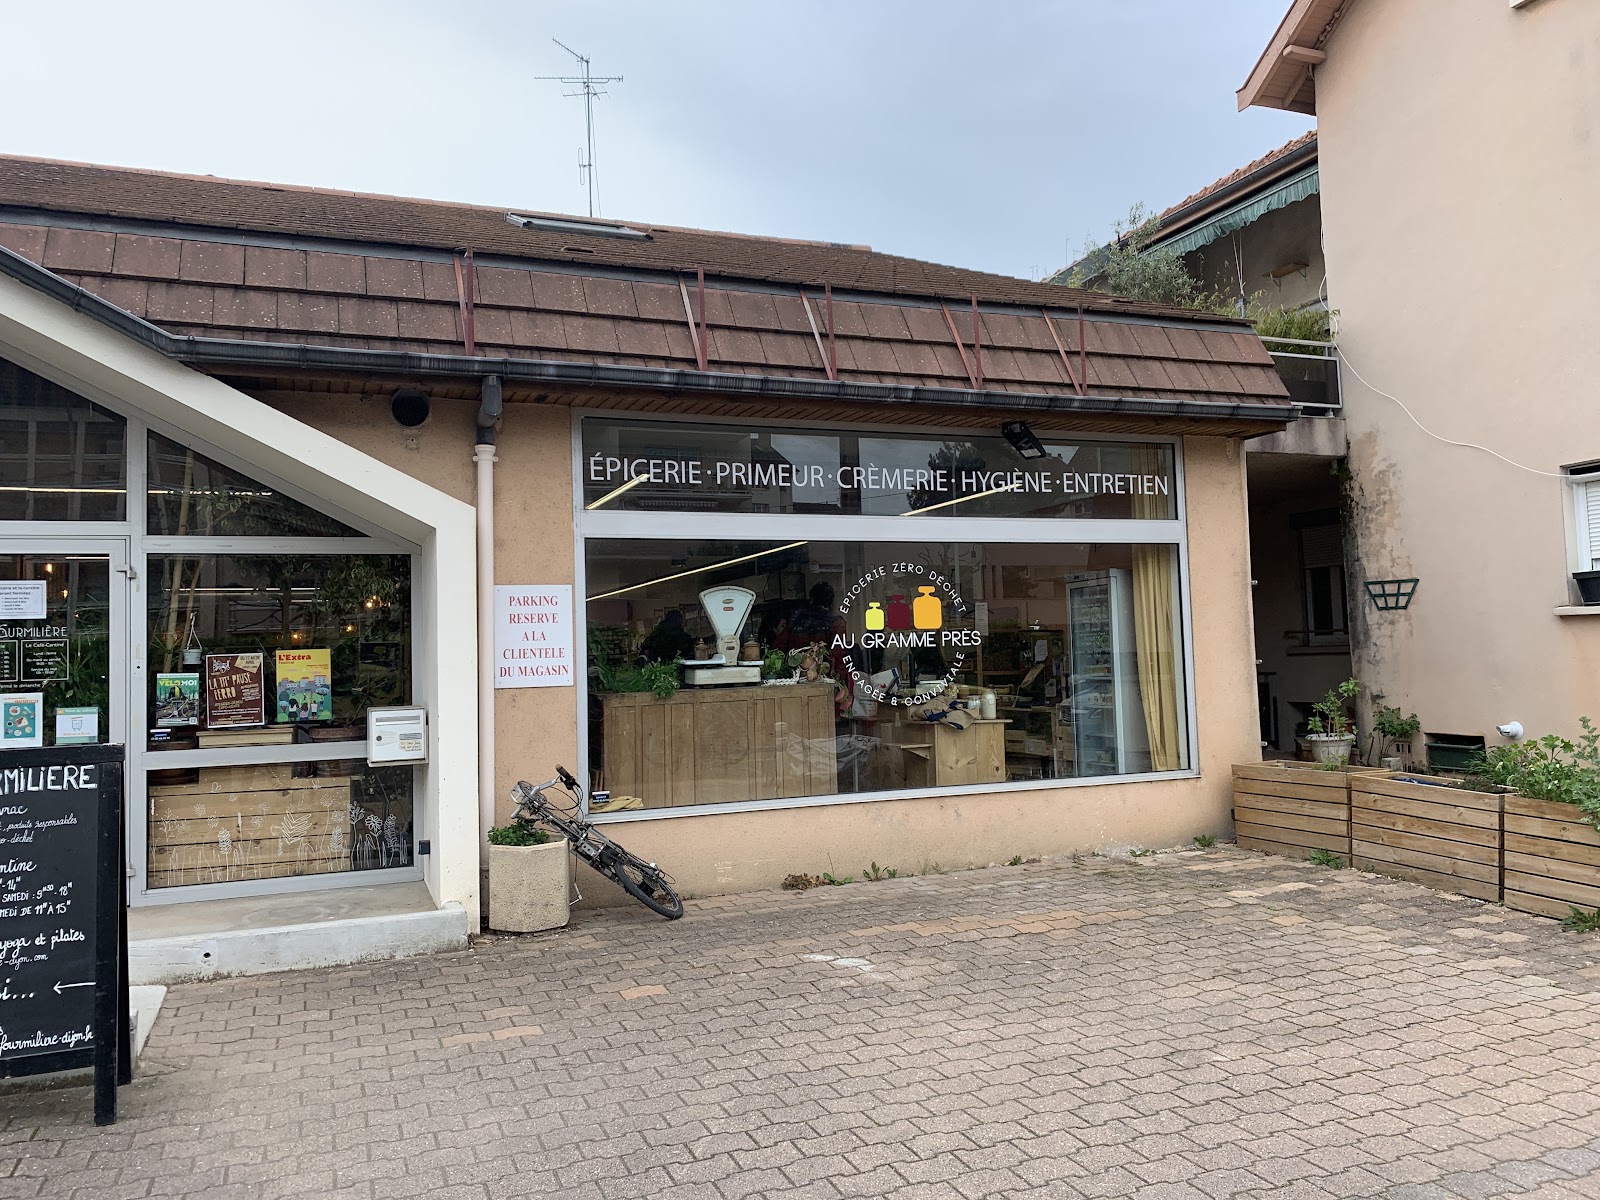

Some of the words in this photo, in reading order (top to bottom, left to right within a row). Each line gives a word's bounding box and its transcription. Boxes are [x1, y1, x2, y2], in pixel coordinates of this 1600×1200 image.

[1064, 472, 1168, 496] ENTRETIEN
[839, 566, 886, 614] ÉPICERIE
[892, 562, 924, 574] ZÉRO
[928, 571, 967, 613] DÉCHET
[509, 595, 558, 607] PARKING
[509, 612, 558, 624] RESERVE
[522, 631, 529, 641] A
[531, 631, 546, 641] LA
[831, 633, 855, 650] AU
[861, 632, 937, 649] GRAMME
[941, 628, 982, 646] PRÈS
[503, 647, 565, 660] CLIENTELE
[499, 666, 515, 678] DU
[517, 664, 569, 677] MAGASIN
[842, 655, 886, 703] ENGAGÉE
[890, 696, 898, 706] &
[904, 651, 965, 706] CONVIVIALE
[209, 678, 218, 690] LA
[232, 672, 252, 686] PAUSE
[214, 687, 237, 700] FERRO
[6, 819, 33, 832] produits
[34, 813, 78, 831] responsables
[19, 906, 33, 917] DE
[0, 937, 31, 959] yoga
[34, 932, 46, 946] et
[51, 928, 86, 950] pilates
